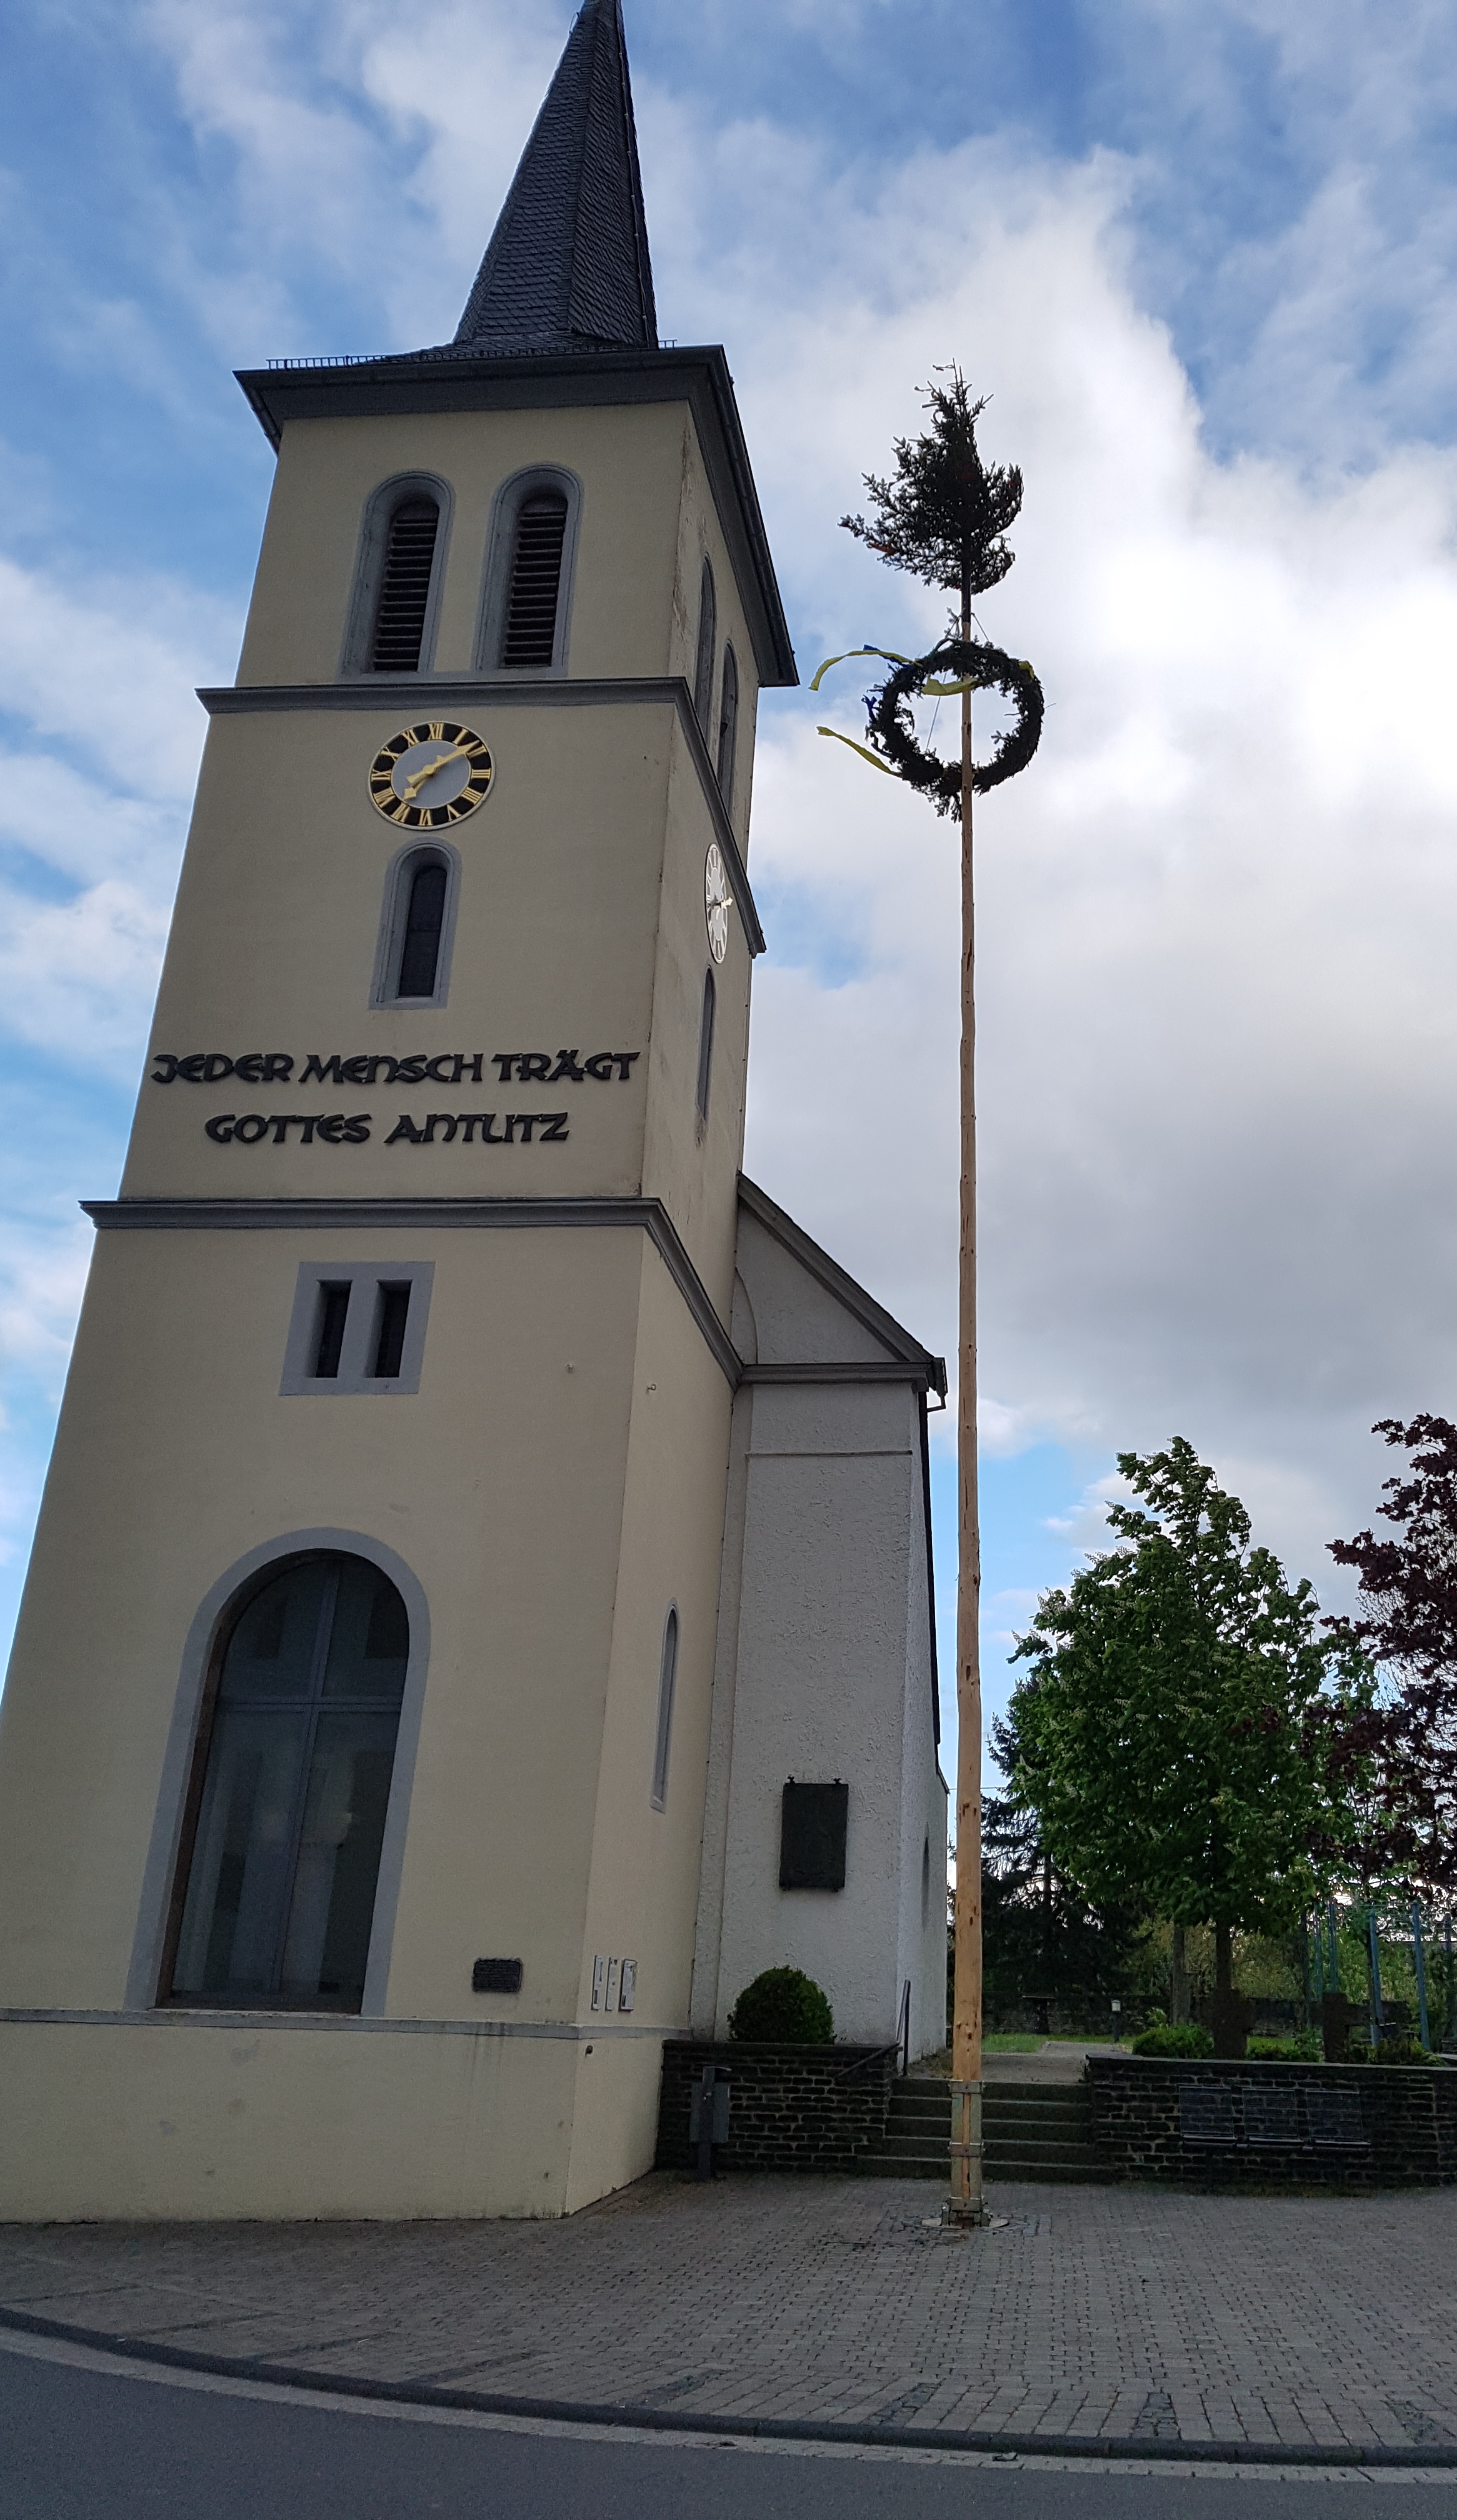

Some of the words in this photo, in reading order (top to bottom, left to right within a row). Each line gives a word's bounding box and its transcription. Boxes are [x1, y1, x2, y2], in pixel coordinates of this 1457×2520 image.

[401, 728, 419, 747] XI
[428, 723, 444, 739] XII
[453, 728, 468, 744] I
[381, 746, 401, 761] X
[372, 769, 391, 781] IX
[471, 768, 491, 779] III
[461, 787, 483, 804] IIII
[391, 802, 410, 822] VII
[418, 809, 433, 826] VI
[447, 804, 461, 821] V
[150, 1053, 294, 1085] JEDER
[491, 1049, 641, 1082] TRÄGT
[204, 1114, 373, 1145] GOTTES
